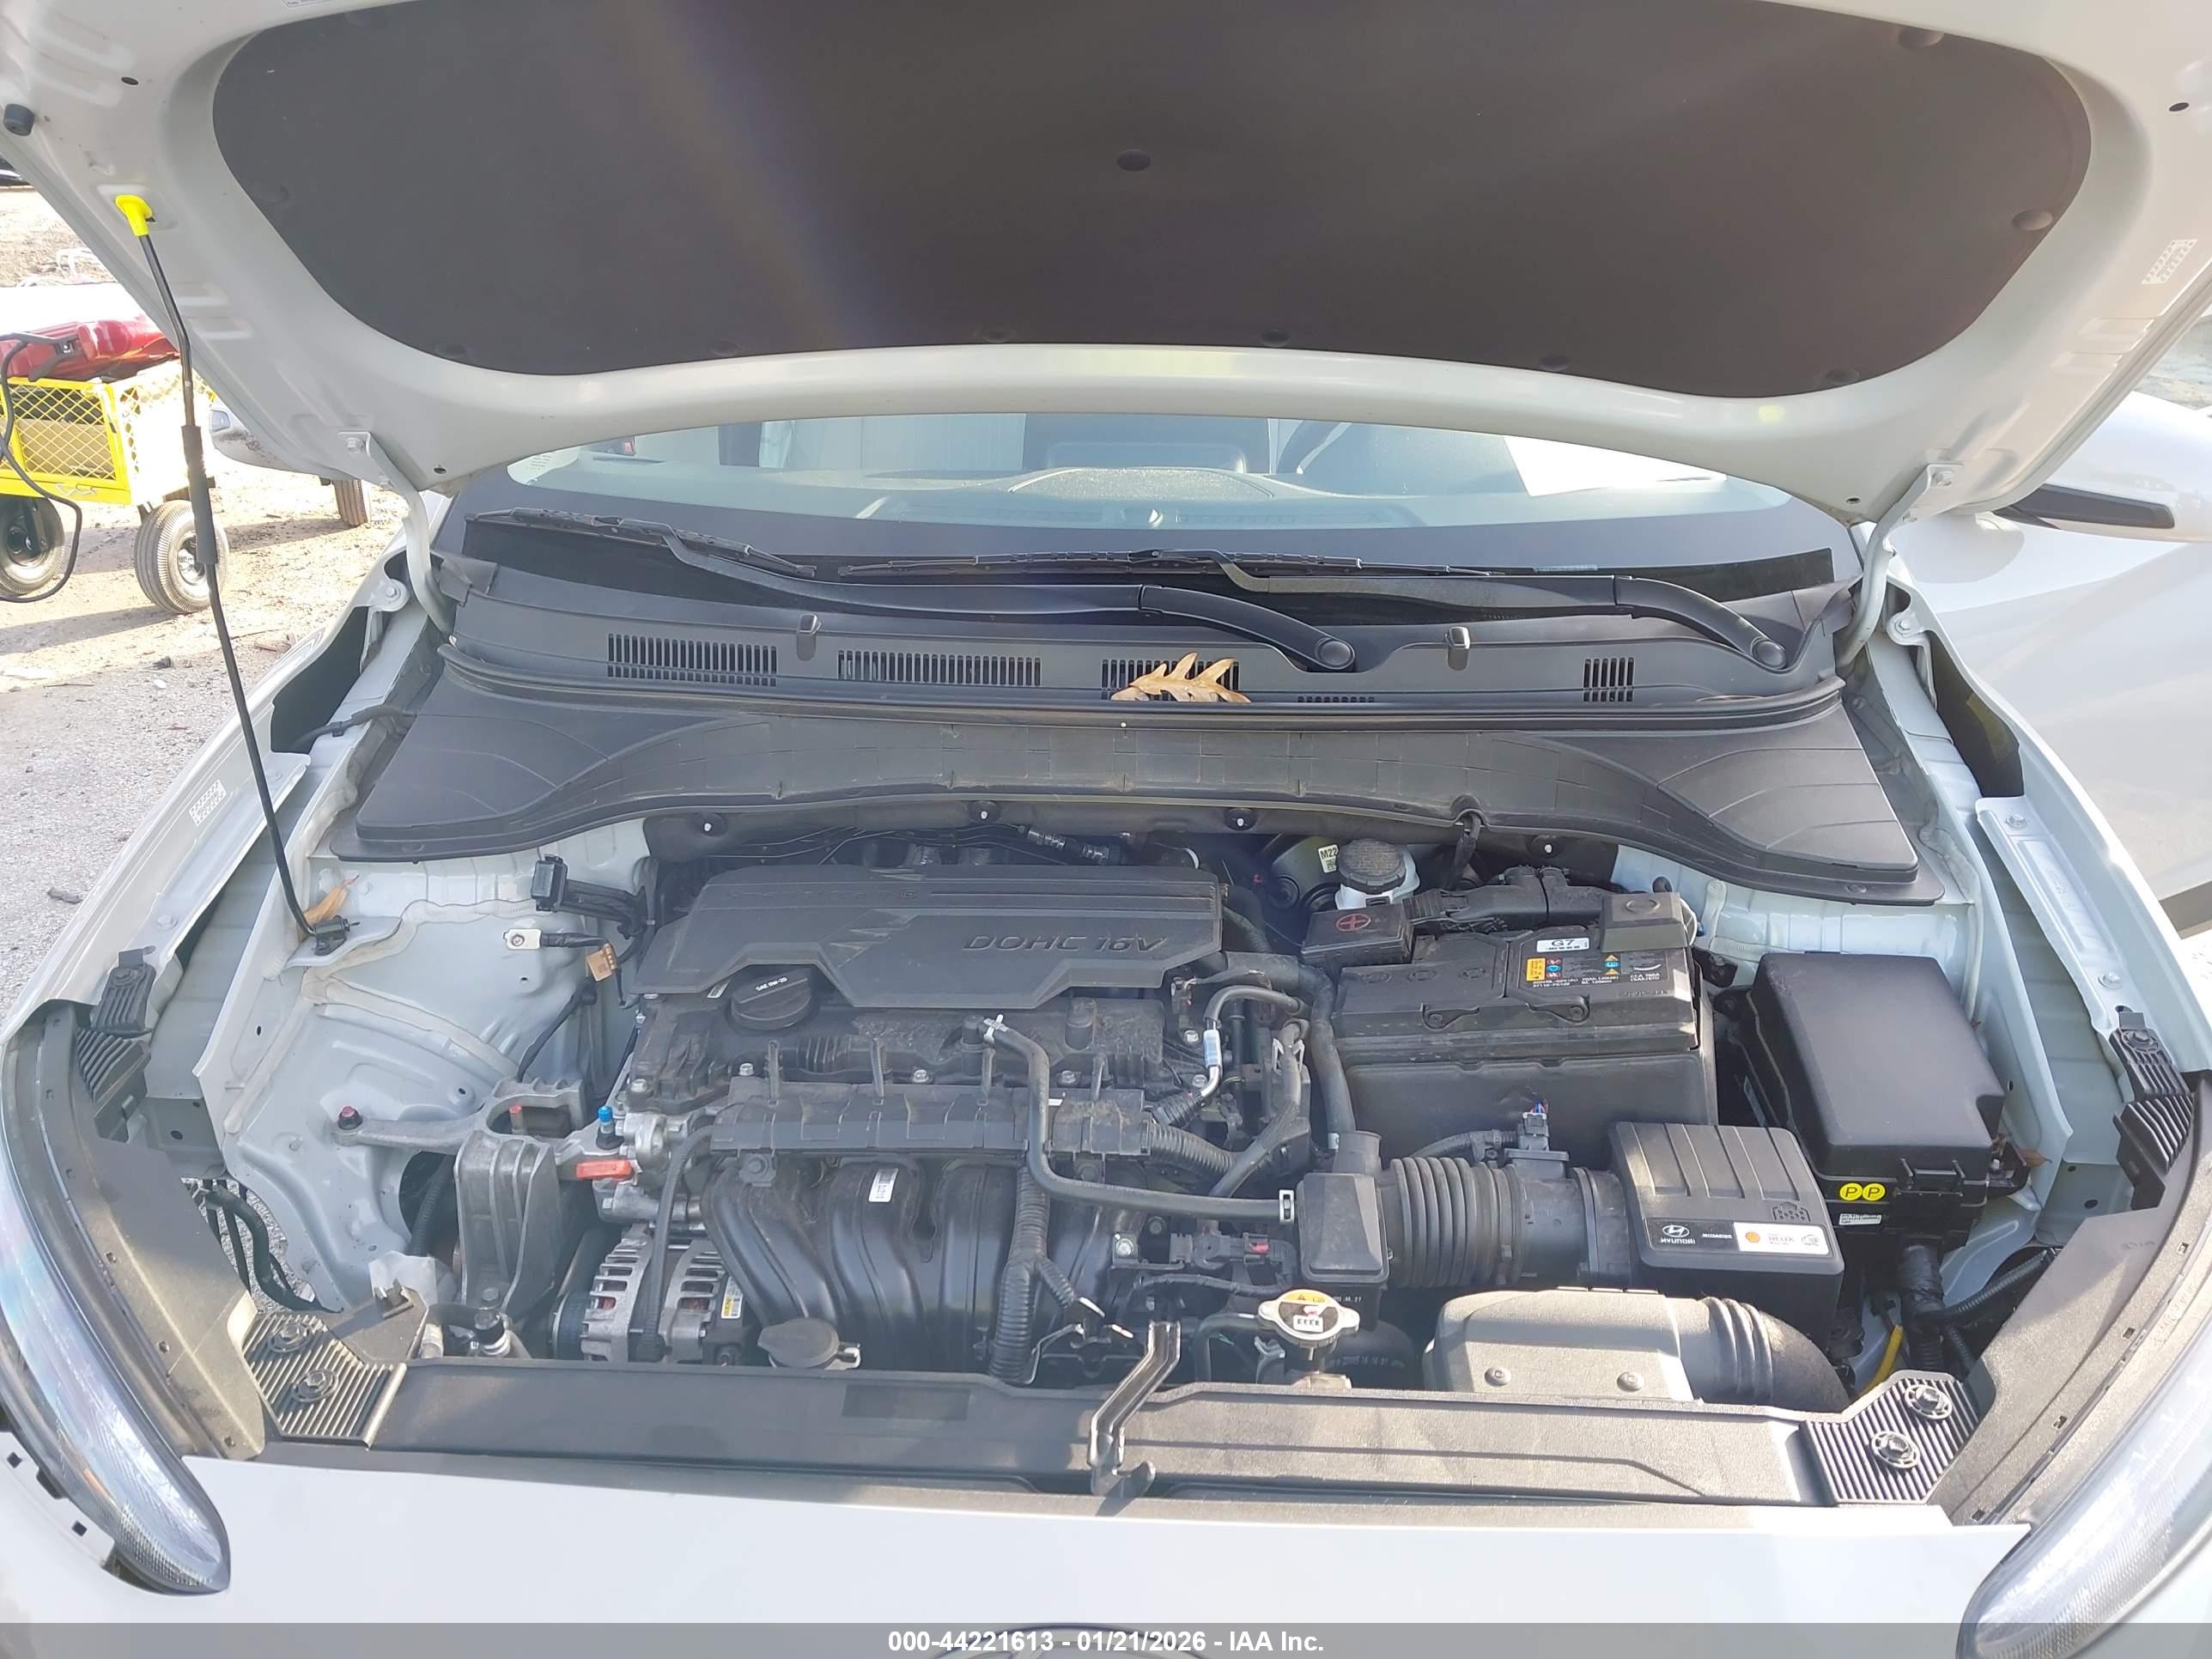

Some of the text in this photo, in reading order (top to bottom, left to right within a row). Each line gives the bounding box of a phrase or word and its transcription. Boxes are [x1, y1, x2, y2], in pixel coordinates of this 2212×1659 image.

[1320, 848, 1338, 860] M22
[962, 935, 1168, 952] DOHC 16V
[1845, 1187, 1881, 1198] P P
